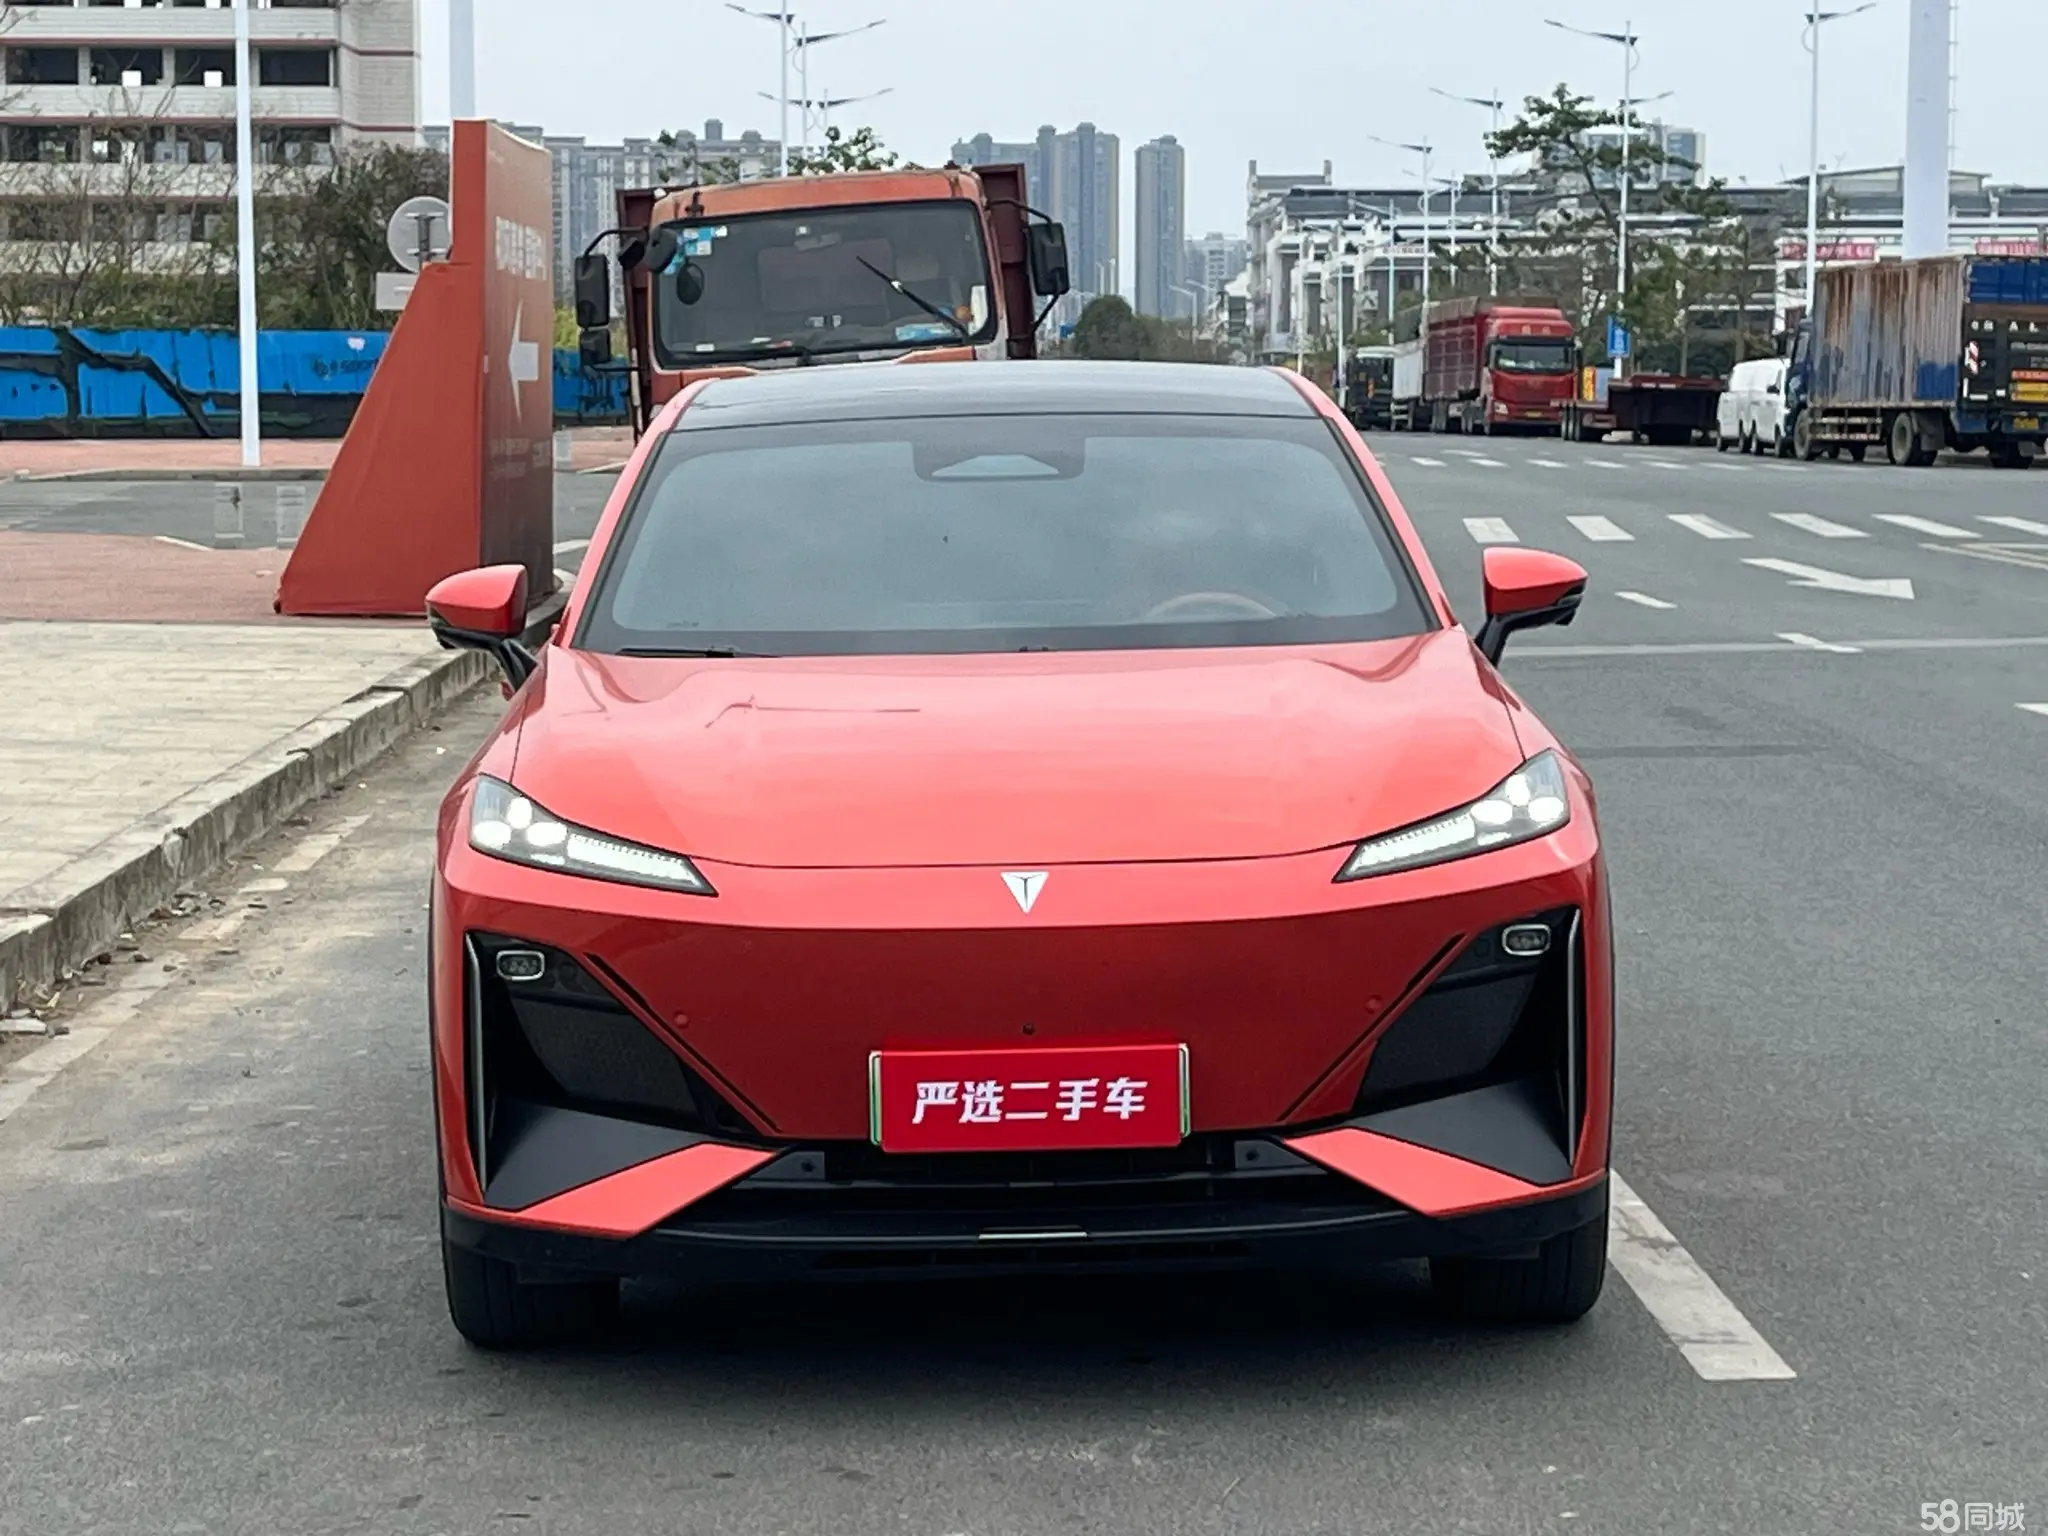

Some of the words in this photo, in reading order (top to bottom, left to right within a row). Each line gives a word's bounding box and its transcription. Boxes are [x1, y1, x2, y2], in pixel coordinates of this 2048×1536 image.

[912, 1076, 1148, 1124] 严选二手车
